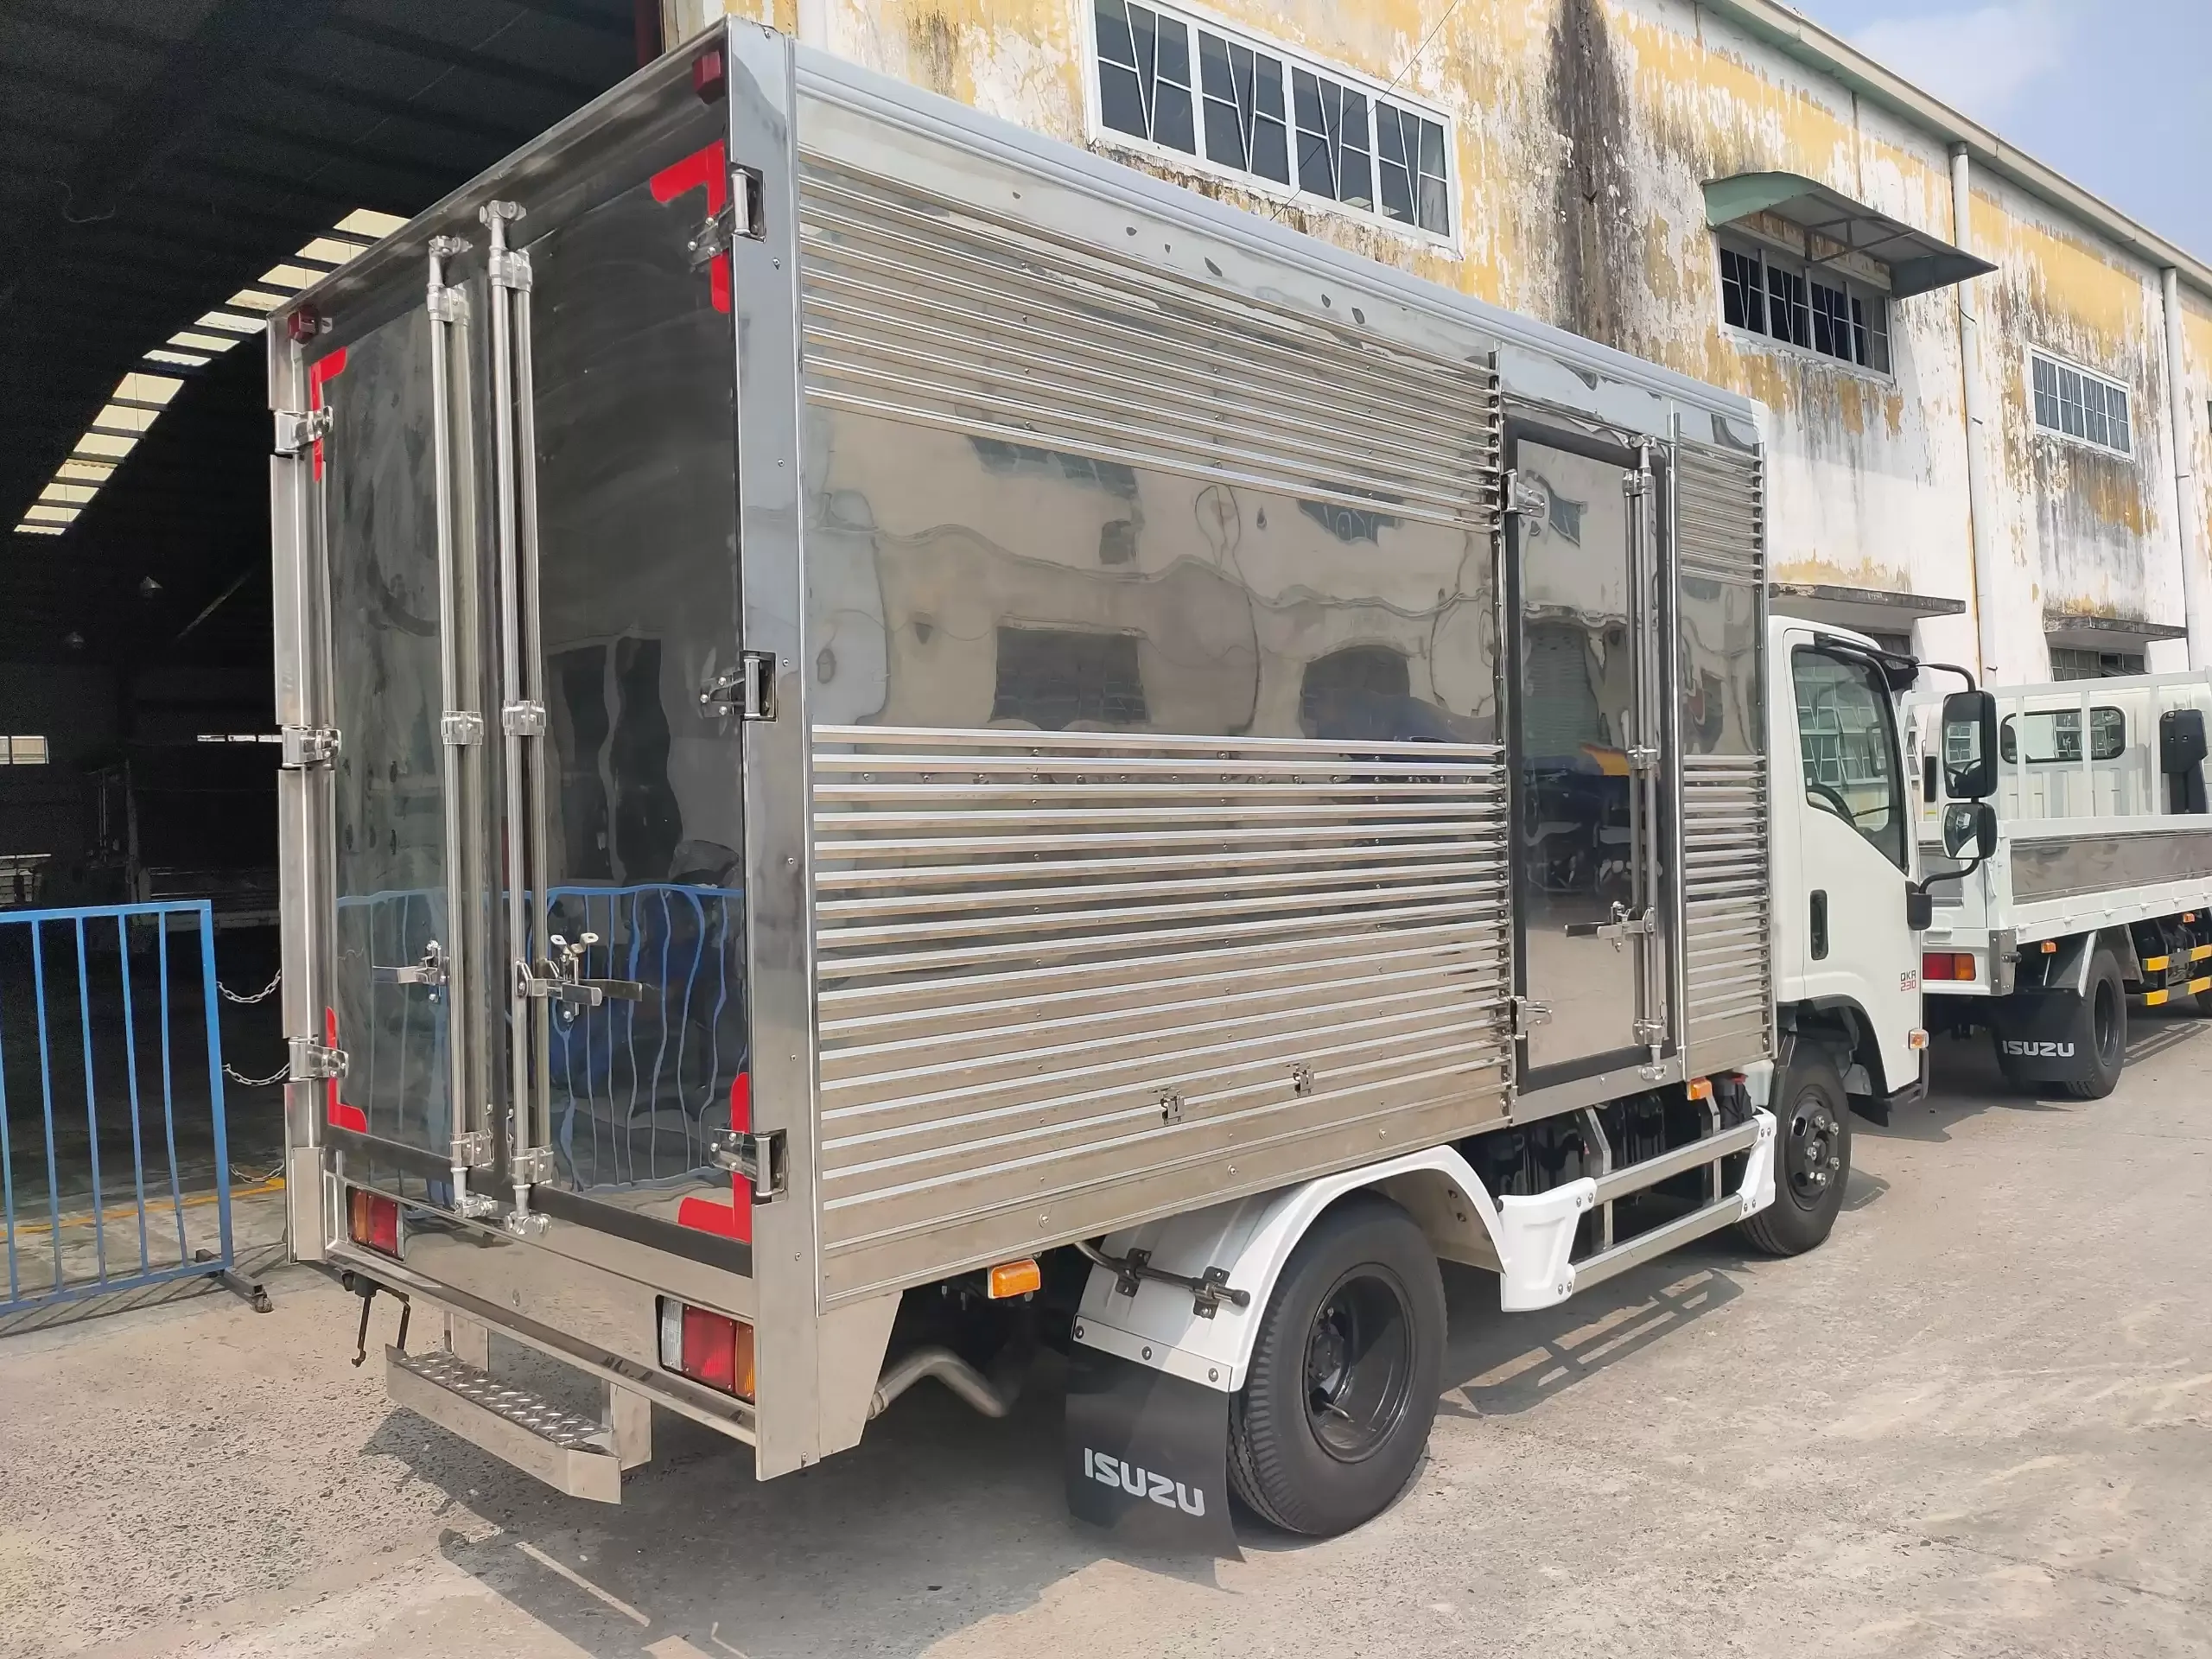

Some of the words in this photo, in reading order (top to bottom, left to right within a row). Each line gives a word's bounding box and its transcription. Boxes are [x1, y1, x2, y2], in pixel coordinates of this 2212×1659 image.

[1900, 969, 1916, 982] QKR
[1900, 979, 1916, 992] 230
[2002, 1040, 2075, 1058] ISUZU
[1084, 1447, 1205, 1517] ISUZU
